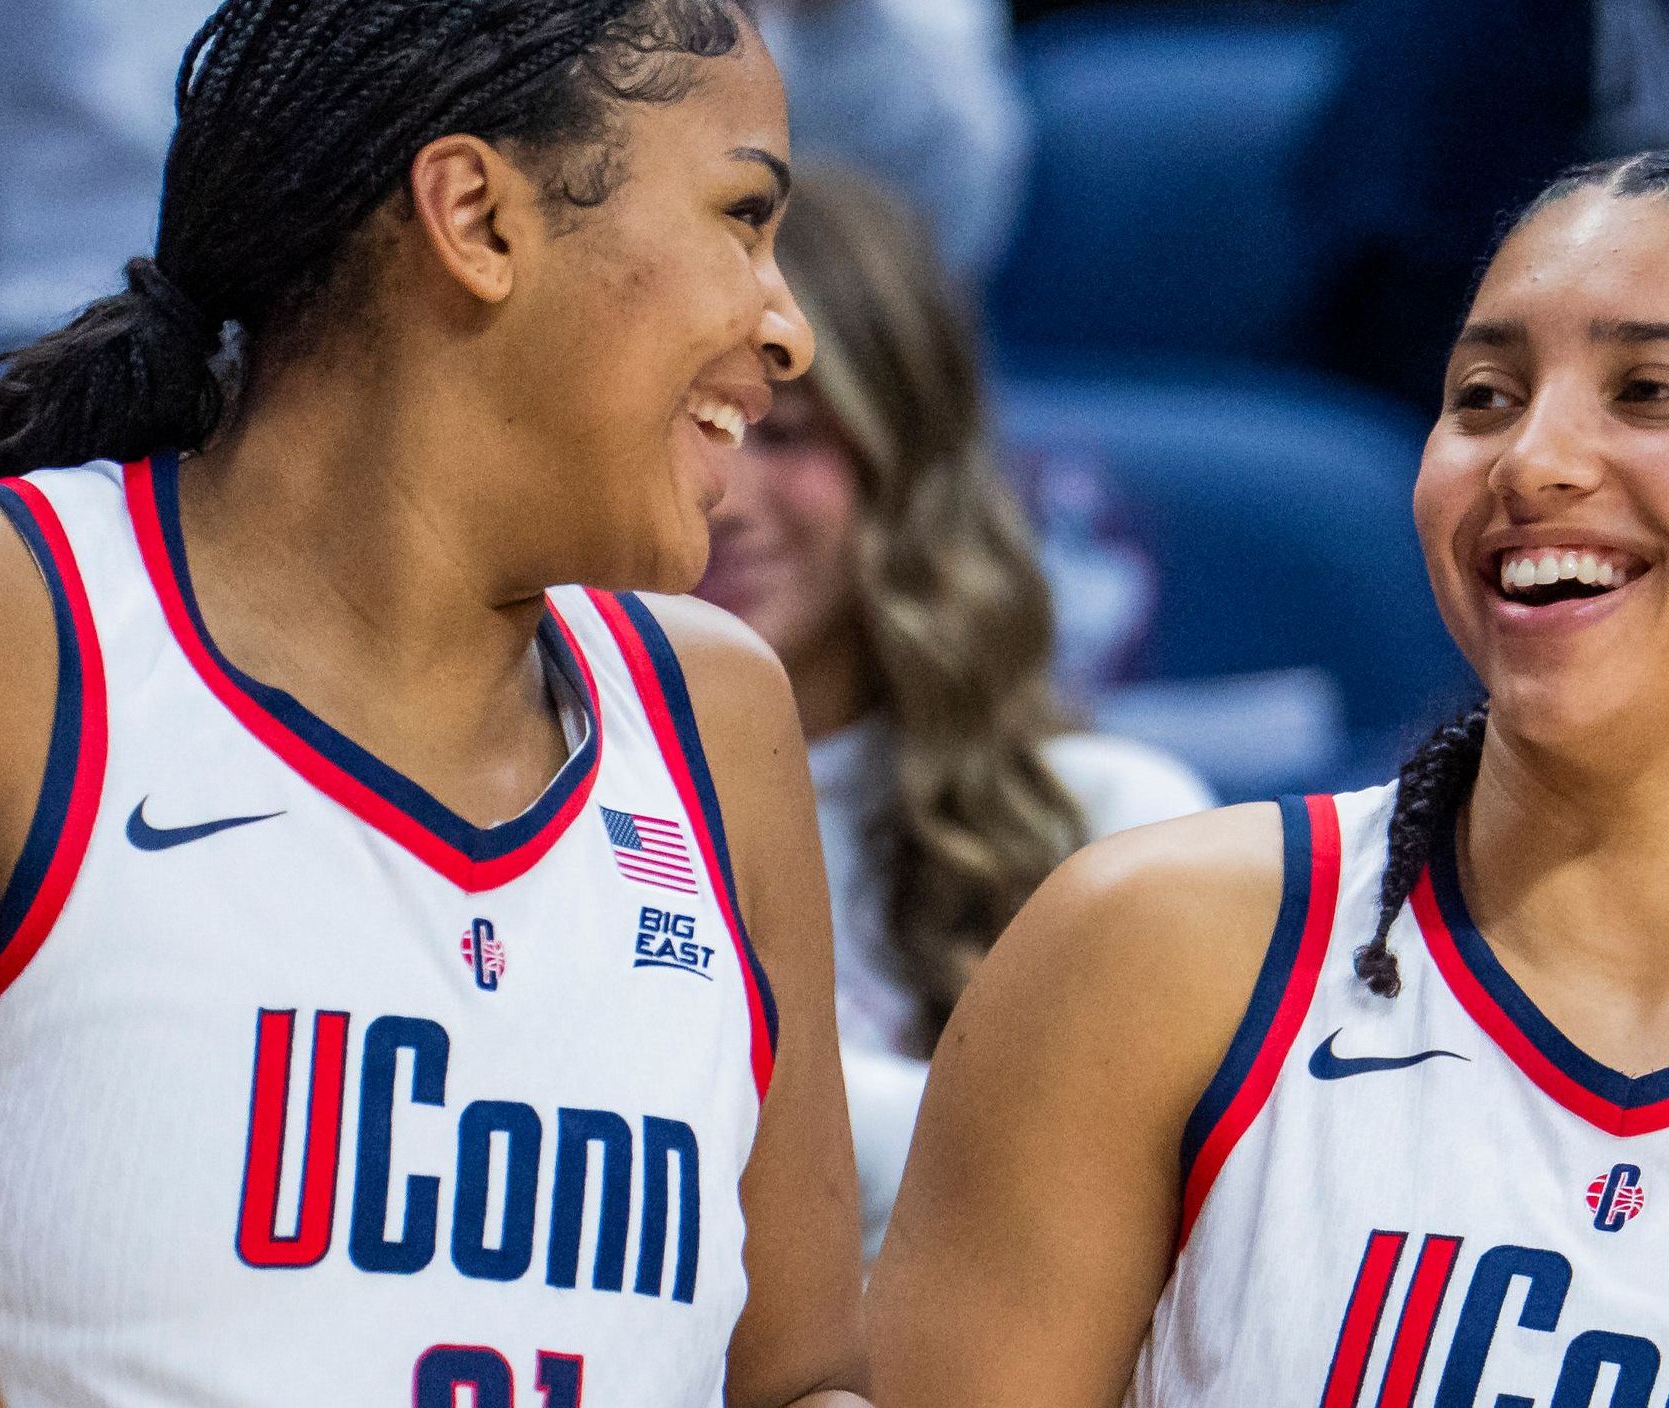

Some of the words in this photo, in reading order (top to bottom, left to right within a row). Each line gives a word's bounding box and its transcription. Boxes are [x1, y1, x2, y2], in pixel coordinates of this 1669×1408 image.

[639, 906, 696, 939] BIG
[635, 933, 715, 968] EAST
[236, 1007, 701, 1304] UConn
